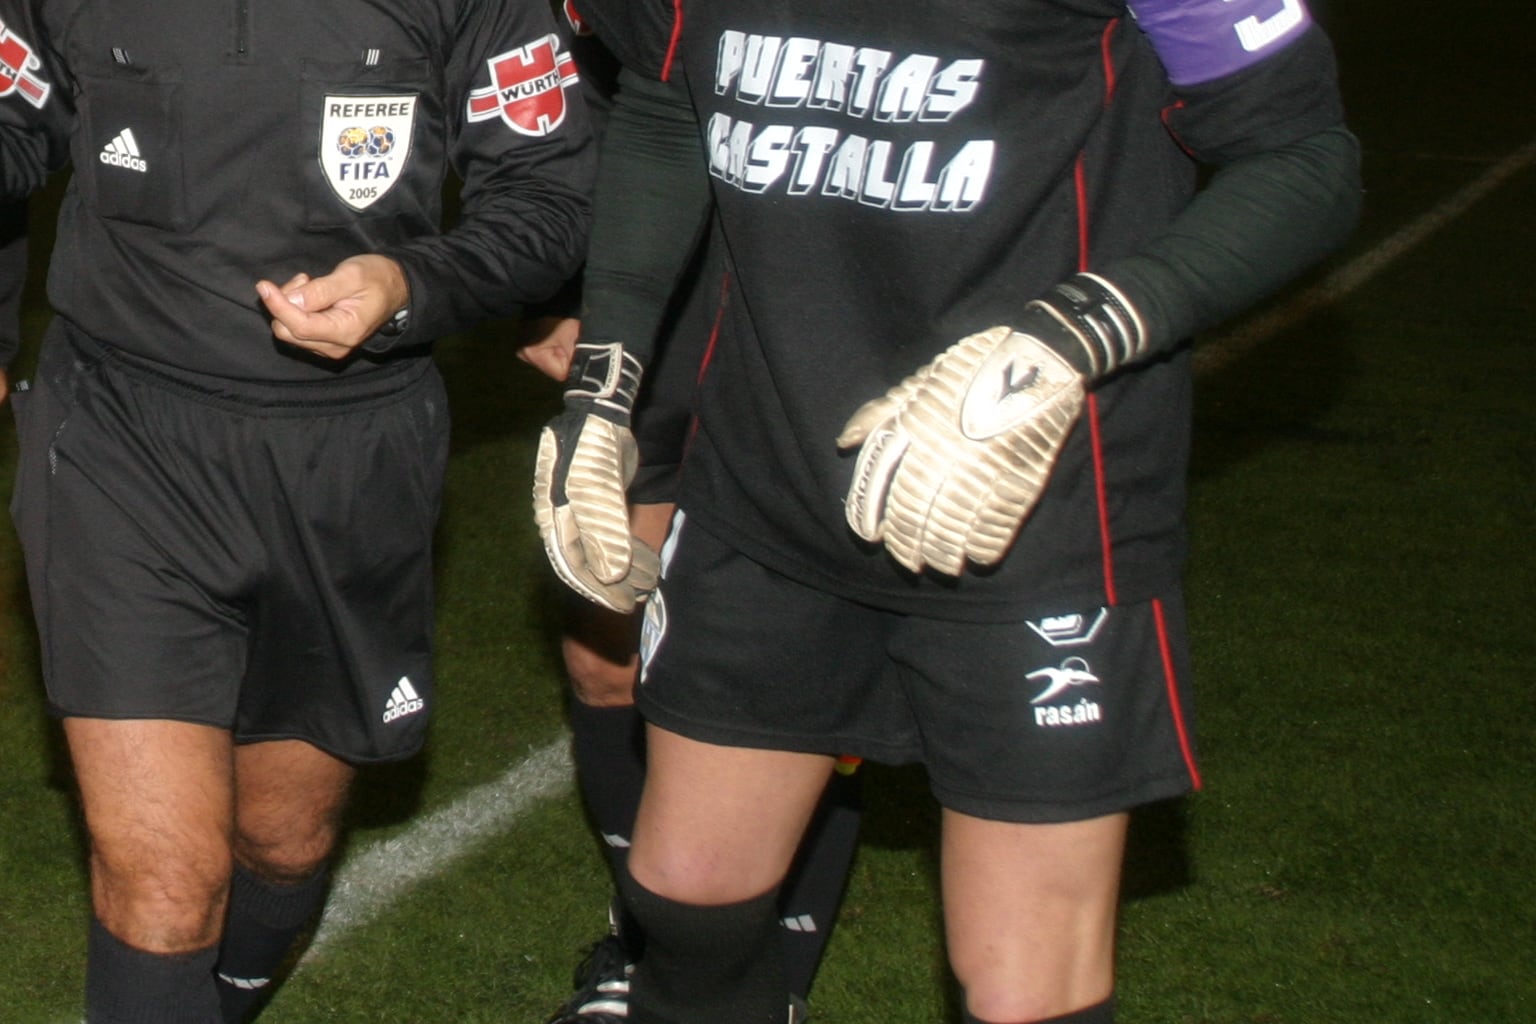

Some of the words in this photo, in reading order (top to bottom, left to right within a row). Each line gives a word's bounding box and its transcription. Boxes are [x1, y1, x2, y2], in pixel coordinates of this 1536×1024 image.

[715, 30, 984, 123] PUERTAS
[330, 102, 410, 118] REFEREE
[100, 151, 147, 172] adidas
[339, 161, 390, 181] FIFA
[707, 112, 995, 212] CASTALLA
[349, 187, 377, 200] 2005
[383, 698, 424, 723] adidas
[1034, 698, 1100, 726] rasán
